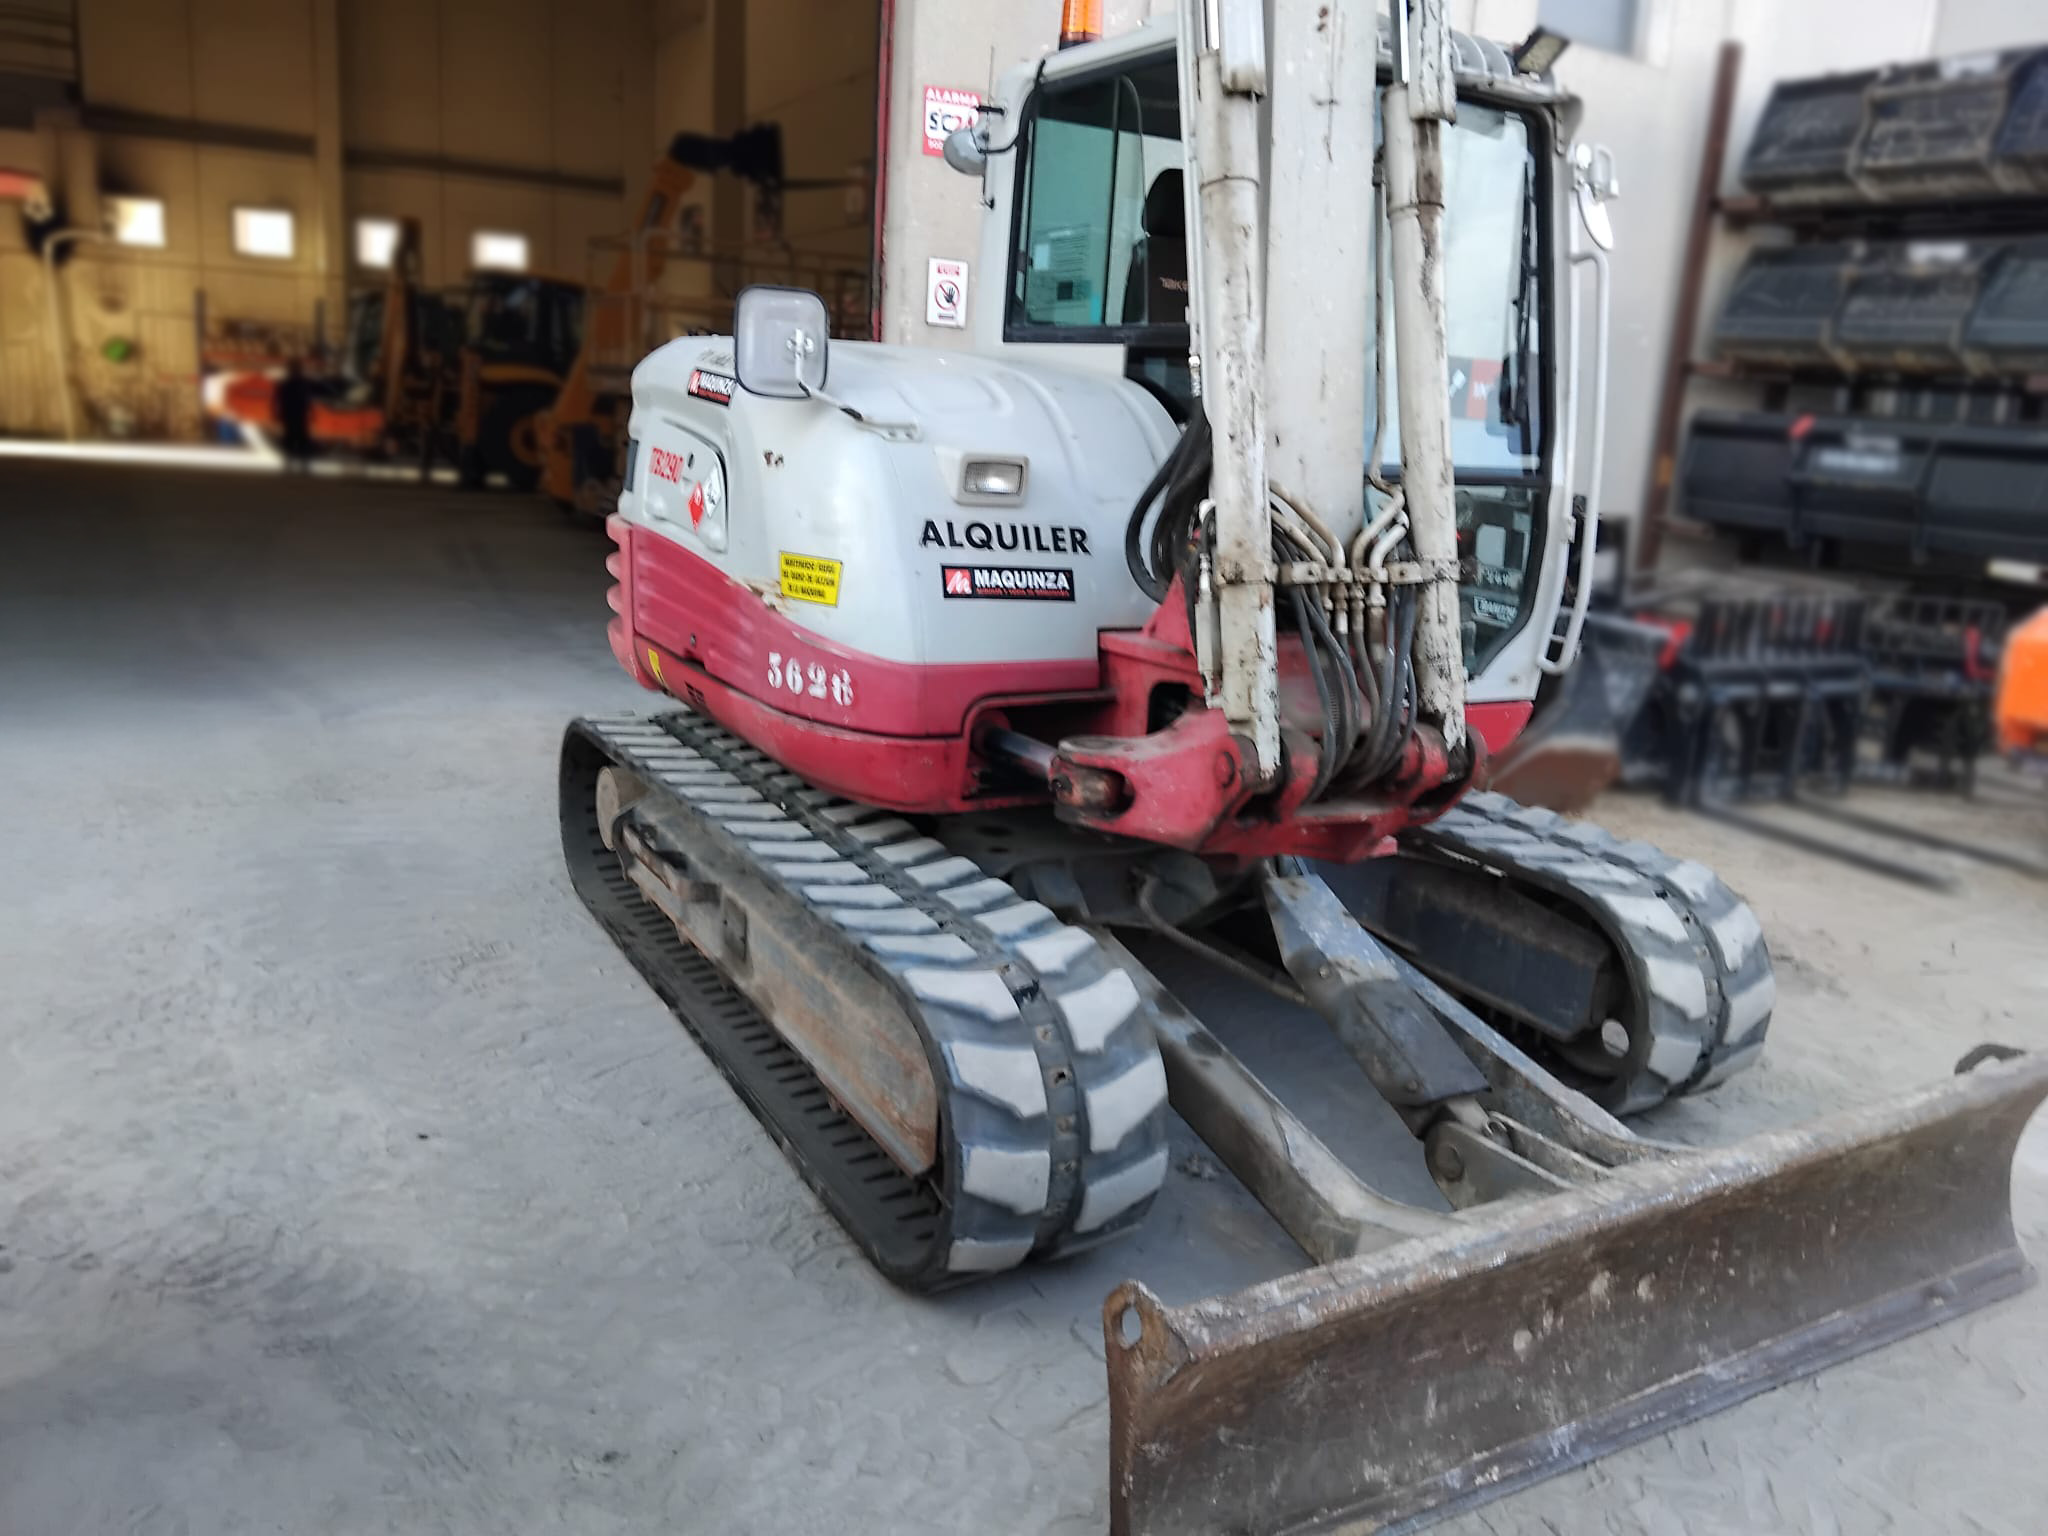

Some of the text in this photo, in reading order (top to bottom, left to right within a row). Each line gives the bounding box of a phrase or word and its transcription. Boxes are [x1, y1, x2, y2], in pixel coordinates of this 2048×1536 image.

[926, 88, 979, 107] ALARMA
[651, 446, 684, 484] TB290
[921, 520, 1092, 555] ALQUILER
[974, 569, 1070, 590] MAQUINZA
